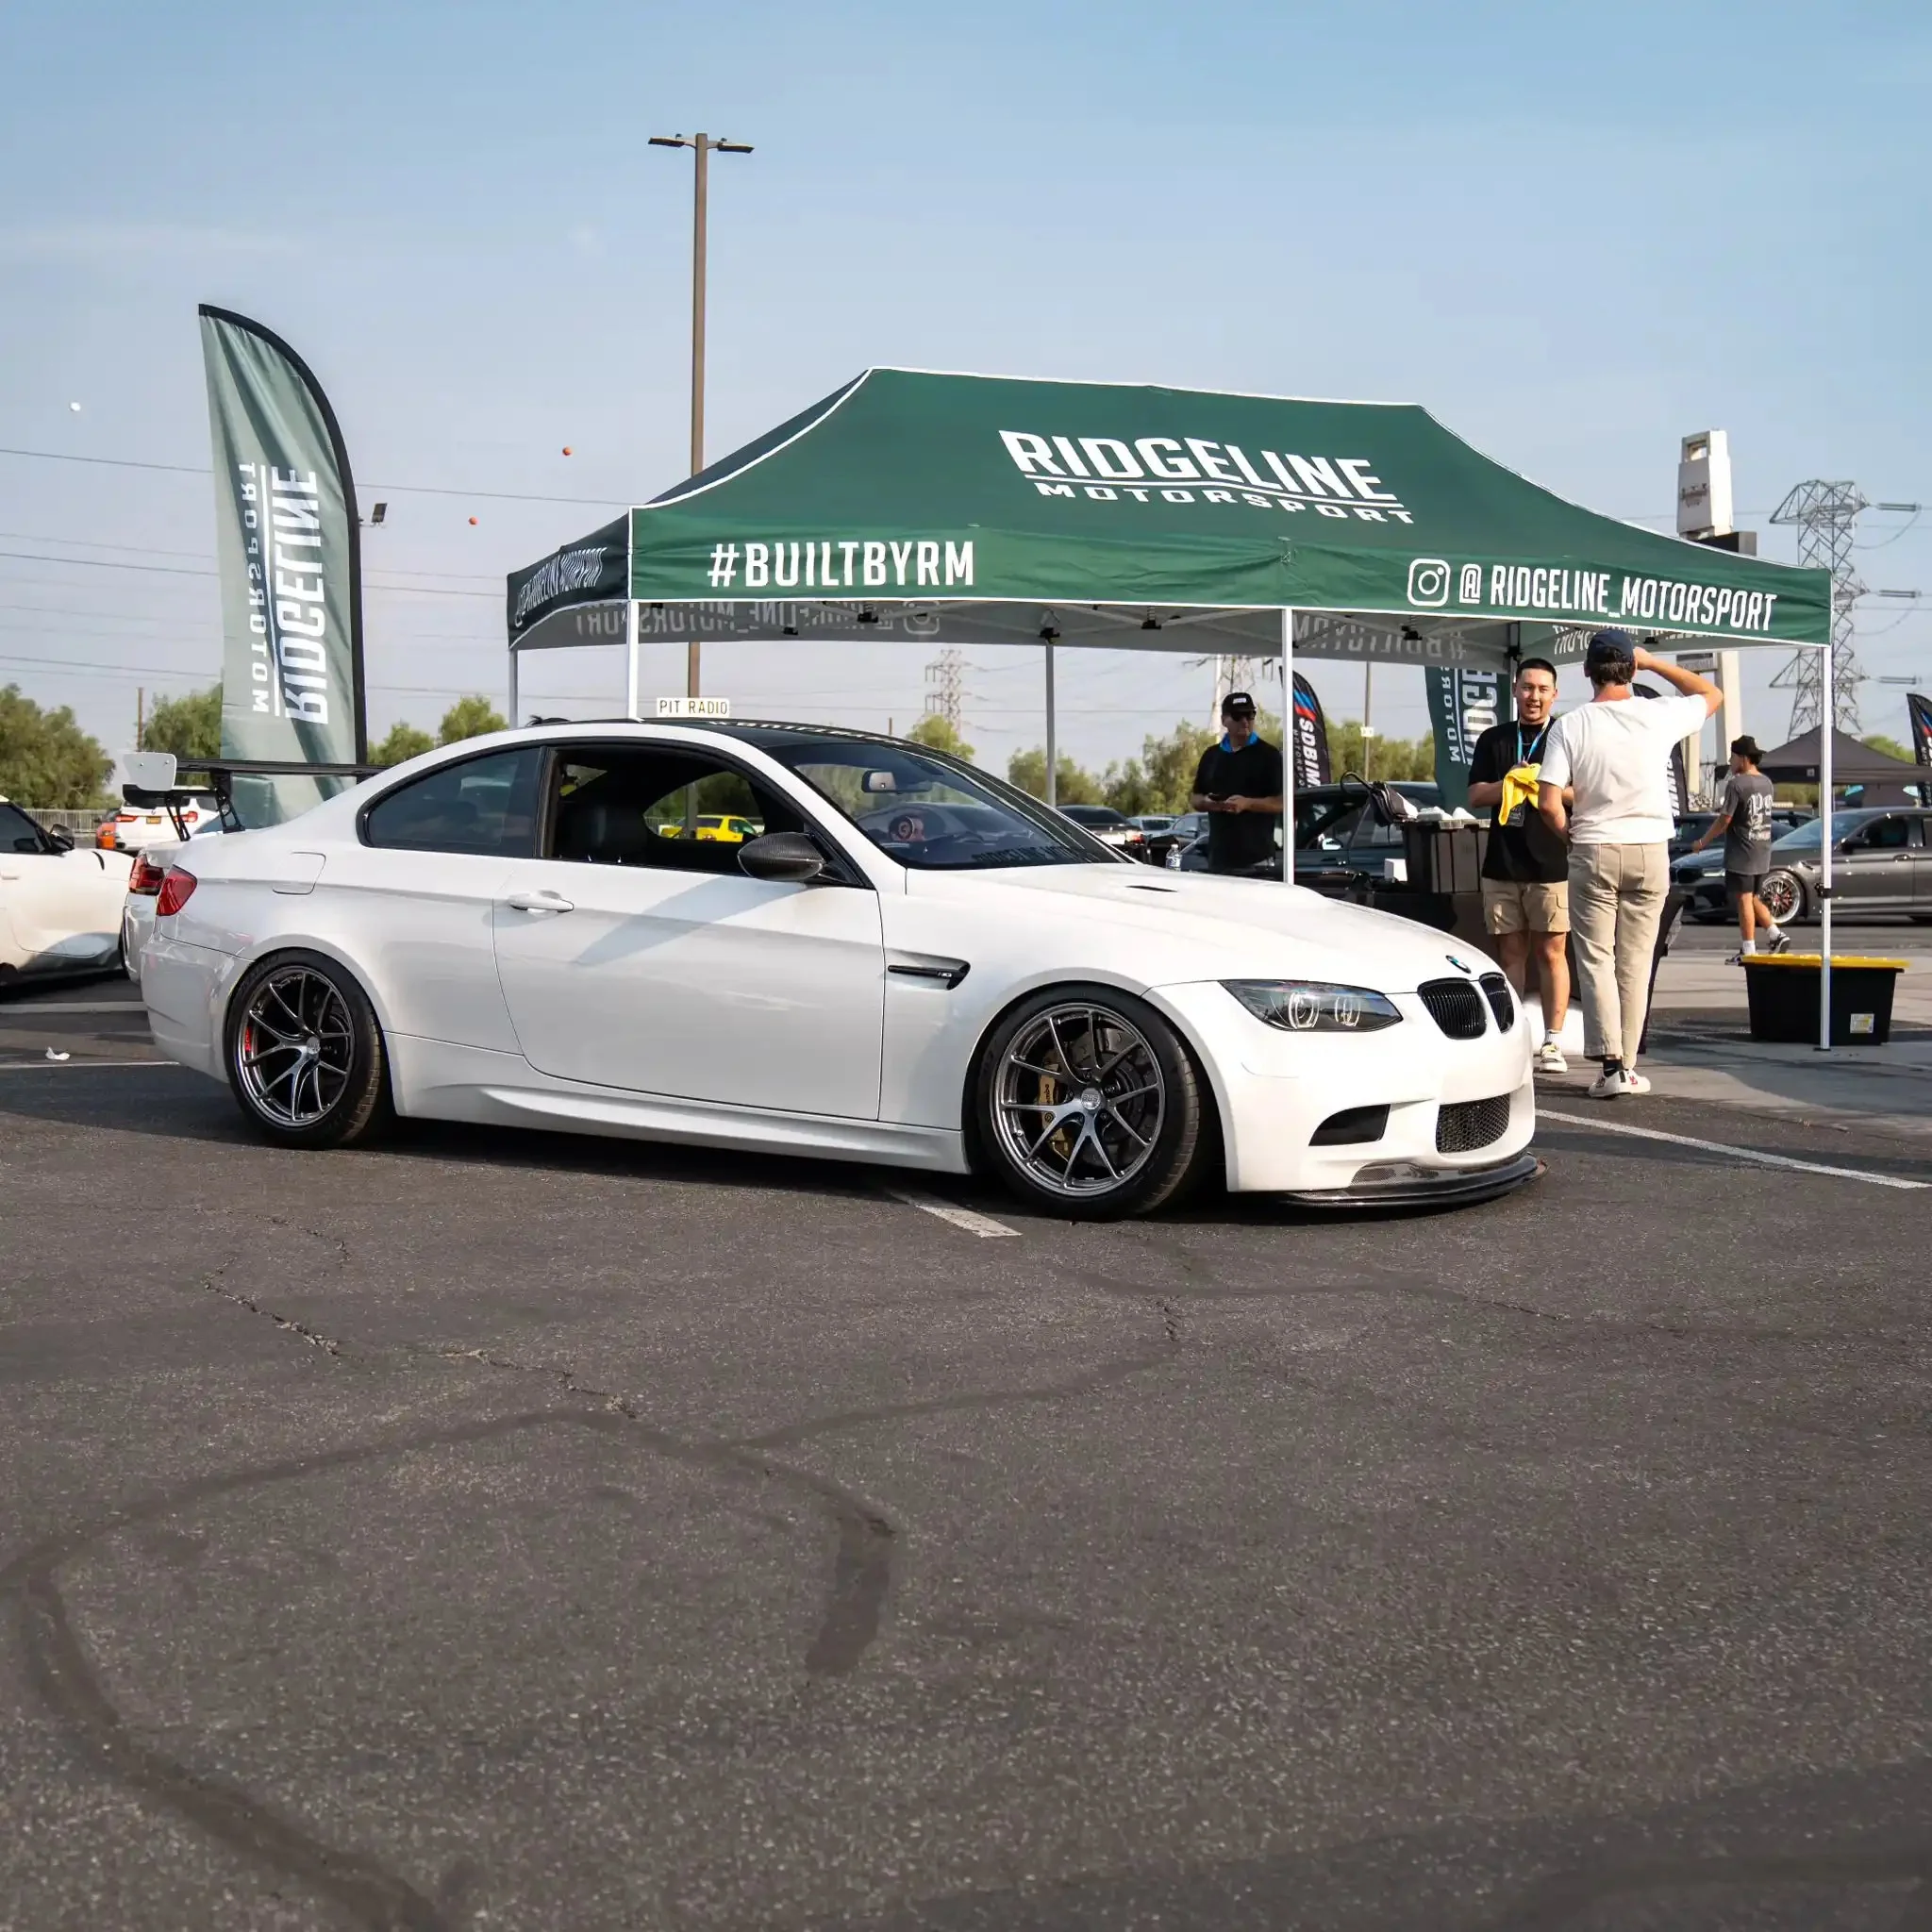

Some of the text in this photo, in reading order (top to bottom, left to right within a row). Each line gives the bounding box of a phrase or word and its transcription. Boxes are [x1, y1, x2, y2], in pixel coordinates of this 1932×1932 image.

[999, 430, 1397, 501] RIDGELINE
[1034, 482, 1415, 525] MOTORSPORT
[708, 541, 974, 588] #BUILTBYRM
[1490, 564, 1778, 631] RIDGELINE_MOTORSPORT
[659, 699, 727, 714] PIT RADIO
[1299, 717, 1322, 789] SDBIM
